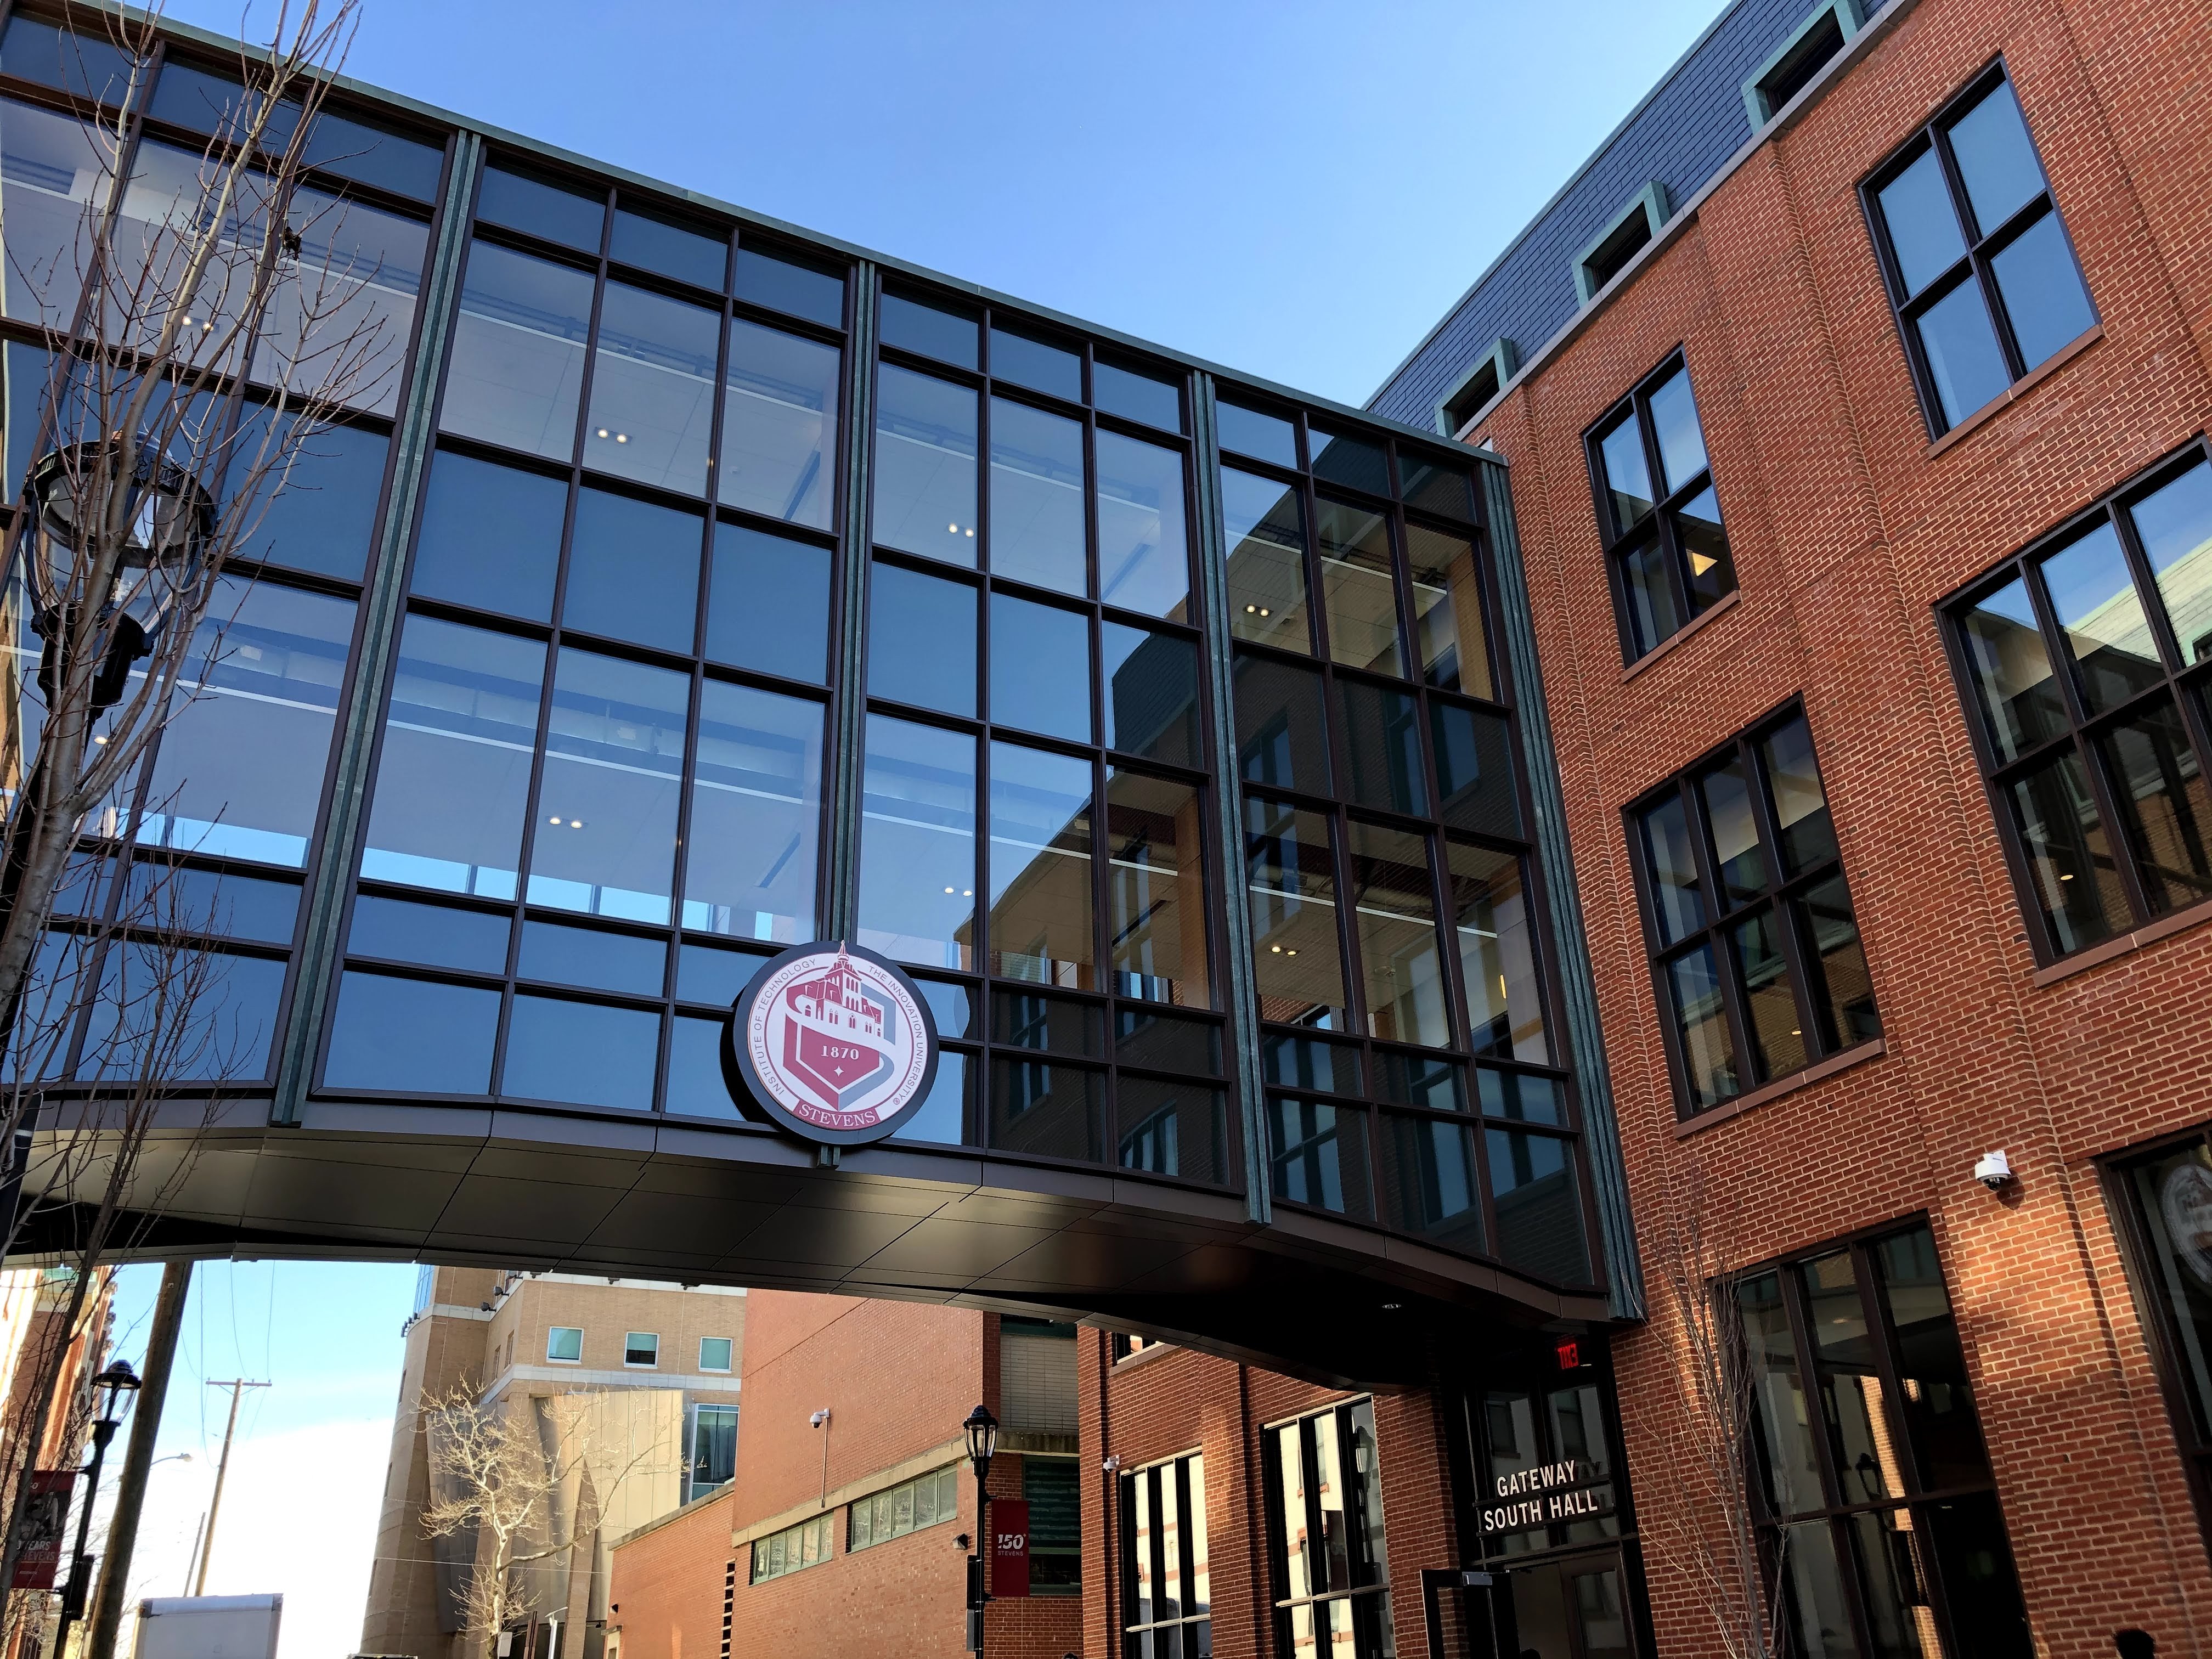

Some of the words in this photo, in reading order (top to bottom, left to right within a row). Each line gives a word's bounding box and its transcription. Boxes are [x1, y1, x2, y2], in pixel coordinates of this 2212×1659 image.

[758, 958, 816, 1014] TECHNOLOGY
[869, 966, 887, 980] THE
[888, 981, 922, 1039] INNOVATION
[754, 1015, 763, 1031] OF
[754, 1036, 784, 1095] INSTITUTE
[821, 1045, 859, 1060] 1870
[799, 1104, 876, 1127] STEVENS
[1497, 1460, 1575, 1497] GATEWAY
[1485, 1500, 1542, 1531] SOUTH
[1549, 1490, 1598, 1518] HALL
[21, 1551, 55, 1561] TEVENS
